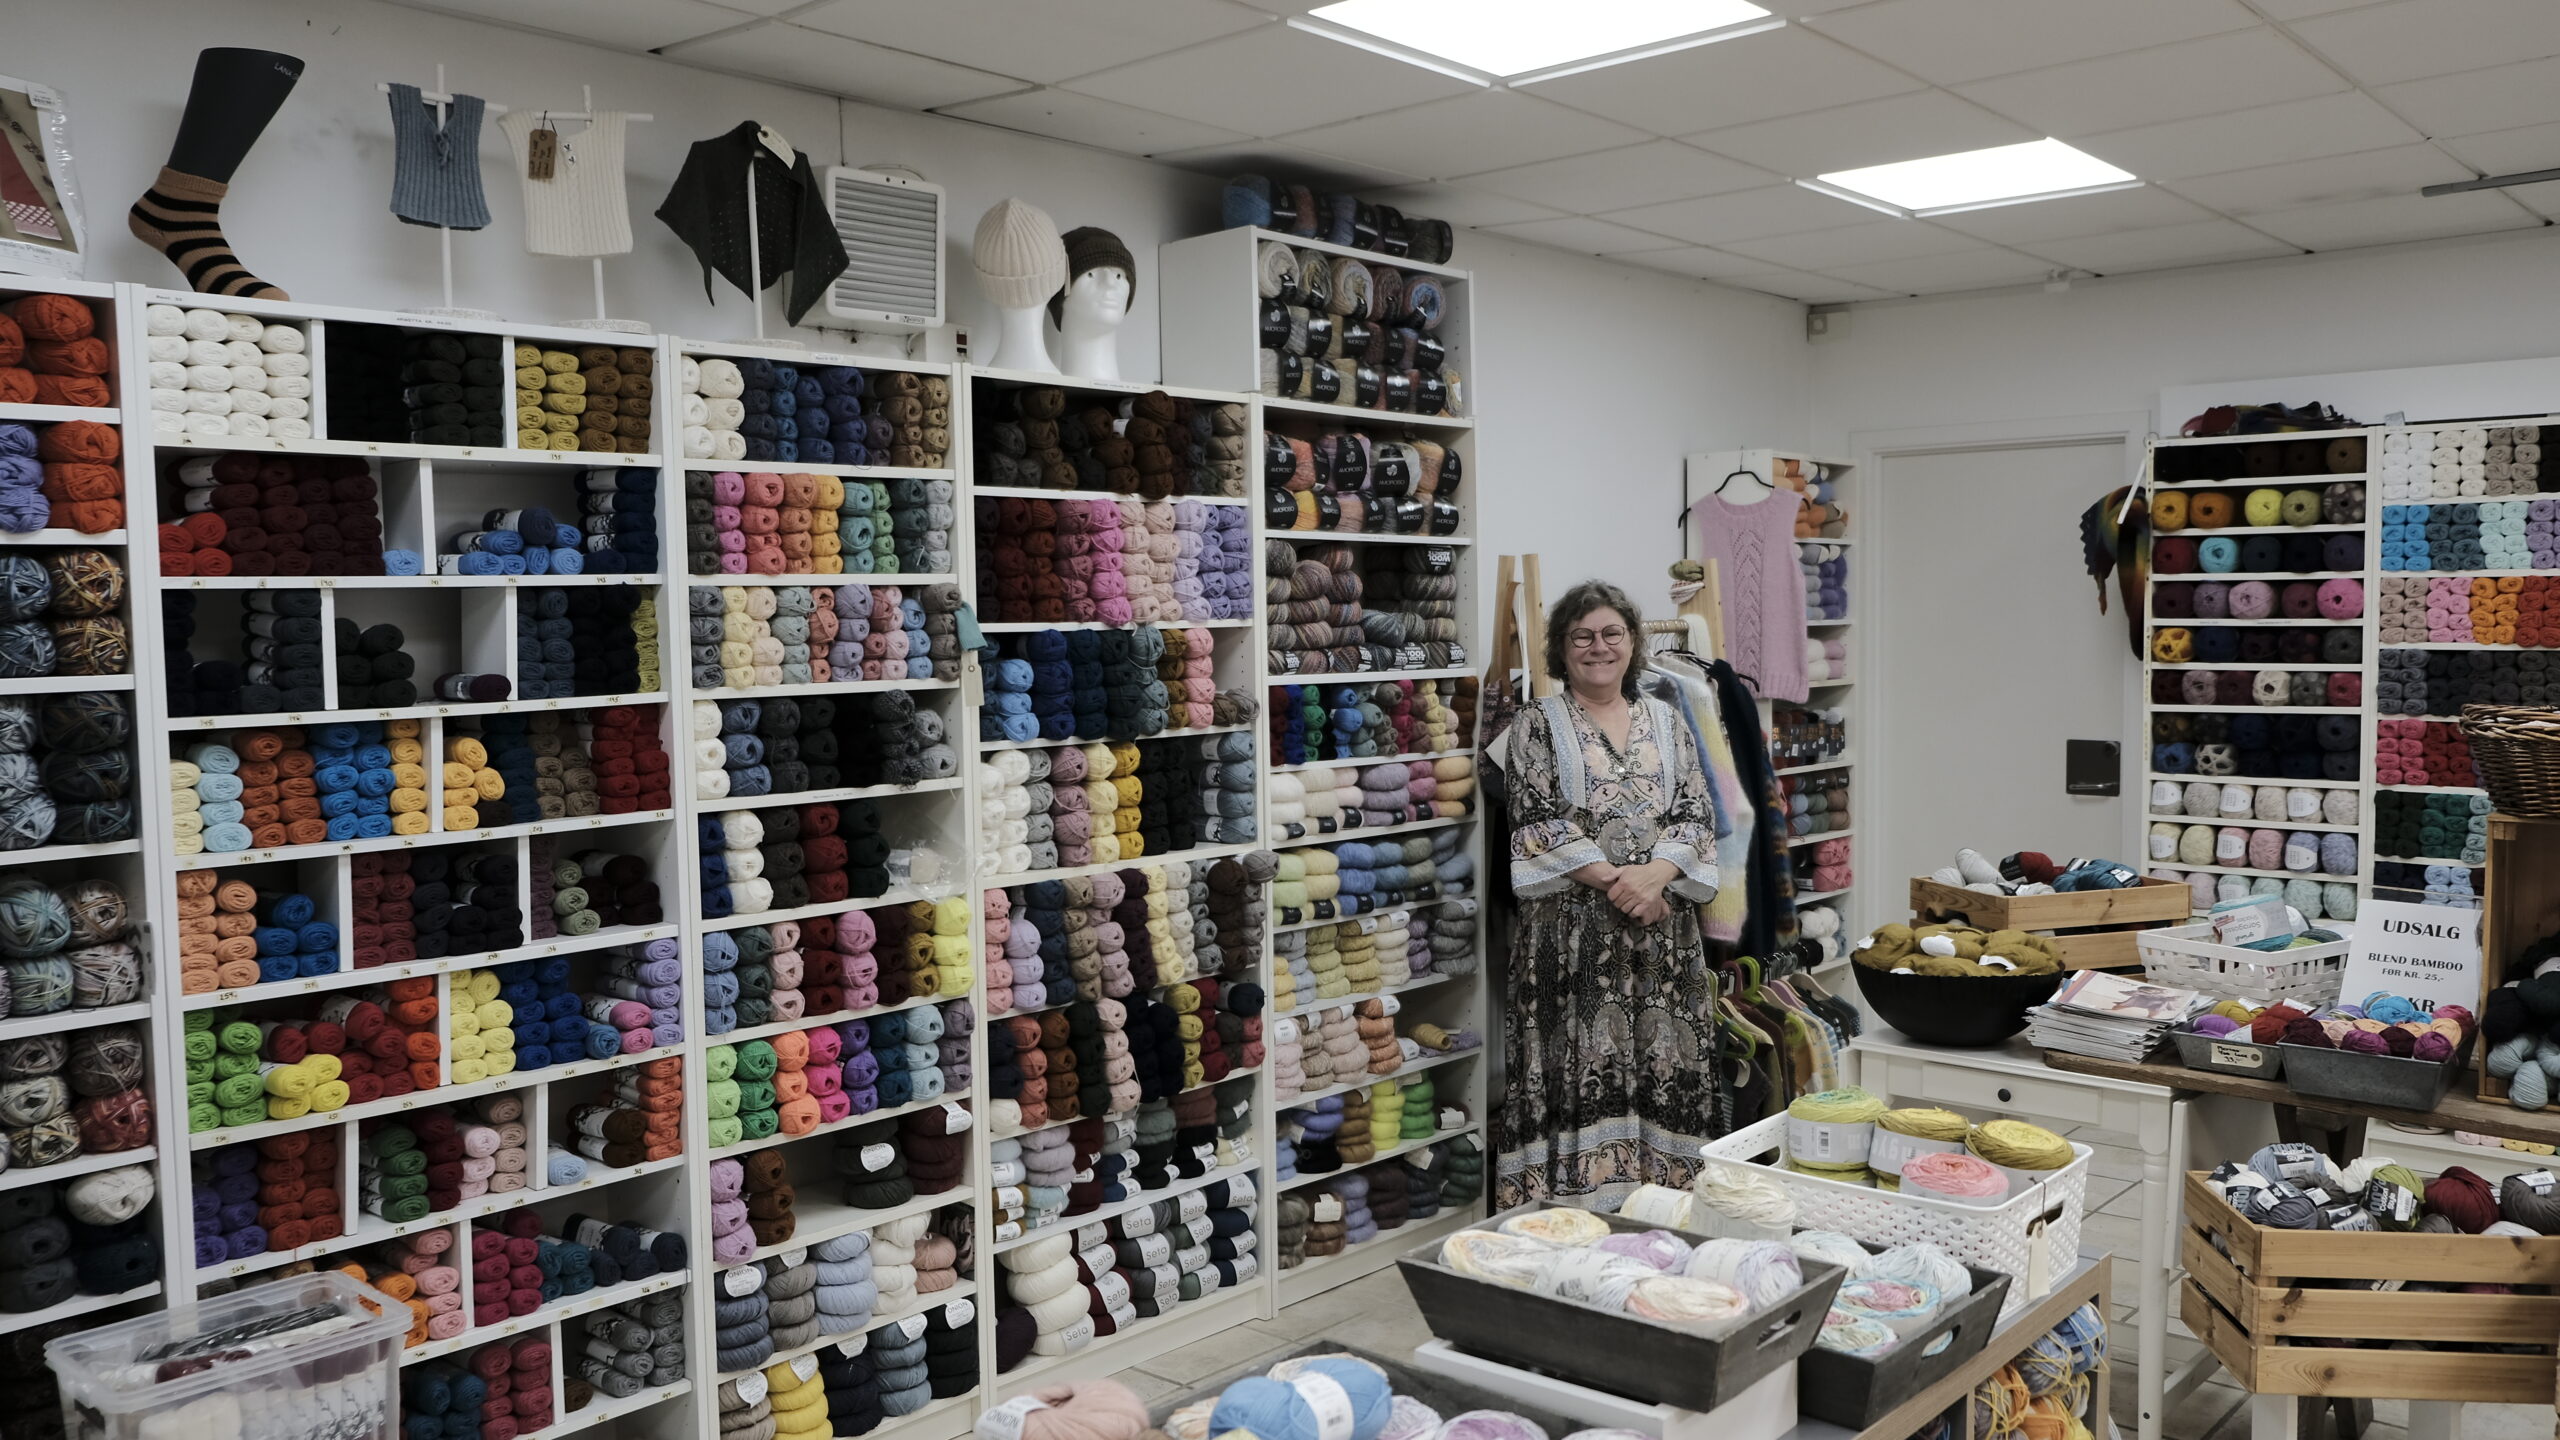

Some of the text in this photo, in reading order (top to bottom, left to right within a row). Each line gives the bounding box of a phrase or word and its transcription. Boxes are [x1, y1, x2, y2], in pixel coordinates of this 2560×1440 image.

[1272, 505, 1295, 514] AMOROSO
[2384, 919, 2461, 940] UDSALG
[2368, 952, 2463, 971] BLEND BAMBOO
[2404, 971, 2420, 979] KR.
[2424, 973, 2444, 982] 25,-
[2272, 1142, 2314, 1152] 100%
[1231, 1194, 1254, 1204] Seta
[2369, 1179, 2388, 1216] 100%
[2380, 1188, 2390, 1211] Cotton
[2388, 1192, 2397, 1210] Style
[1183, 1204, 1205, 1217] Seta
[1126, 1216, 1152, 1230] Seta
[1193, 1224, 1212, 1239] Seta
[1081, 1234, 1104, 1249] Seta
[1239, 1237, 1255, 1251] Seta
[1146, 1245, 1168, 1260] Seta
[1091, 1250, 1113, 1271] Seta
[1184, 1254, 1205, 1269] Seta
[728, 1267, 753, 1279] ONION
[1201, 1272, 1219, 1286] Seta
[1238, 1265, 1255, 1279] Seta
[1158, 1277, 1178, 1289] Seta
[1106, 1286, 1127, 1305] Seta
[1160, 1292, 1178, 1308] Seta
[948, 1301, 968, 1314] ONION
[1065, 1325, 1089, 1341] Seta
[737, 1371, 758, 1387] ONION
